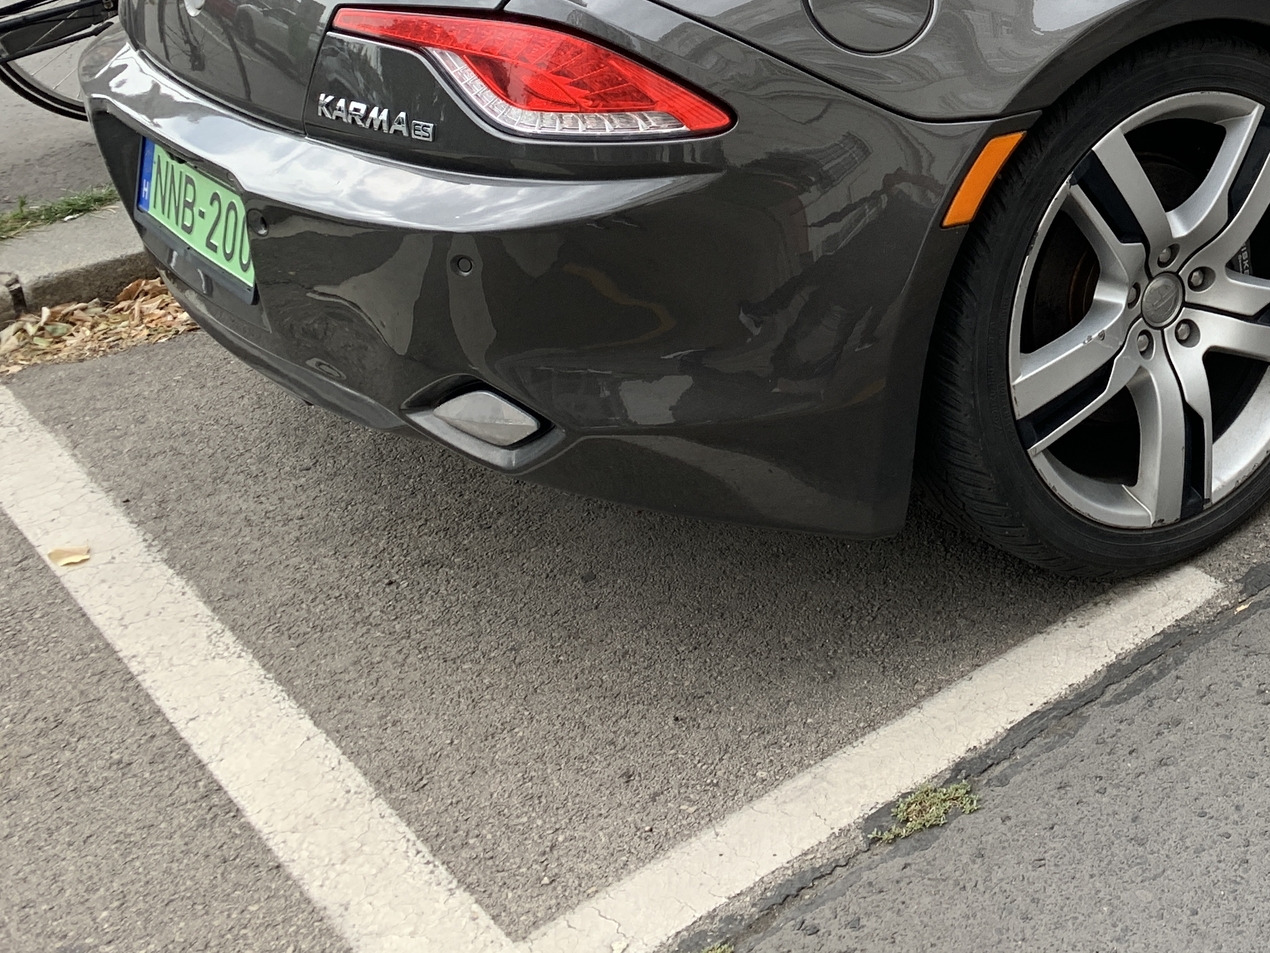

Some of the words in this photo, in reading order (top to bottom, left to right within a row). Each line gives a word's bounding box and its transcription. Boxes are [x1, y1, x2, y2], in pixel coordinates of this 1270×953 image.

[318, 93, 409, 137] KARMA
[412, 122, 432, 140] ES
[141, 179, 149, 199] H
